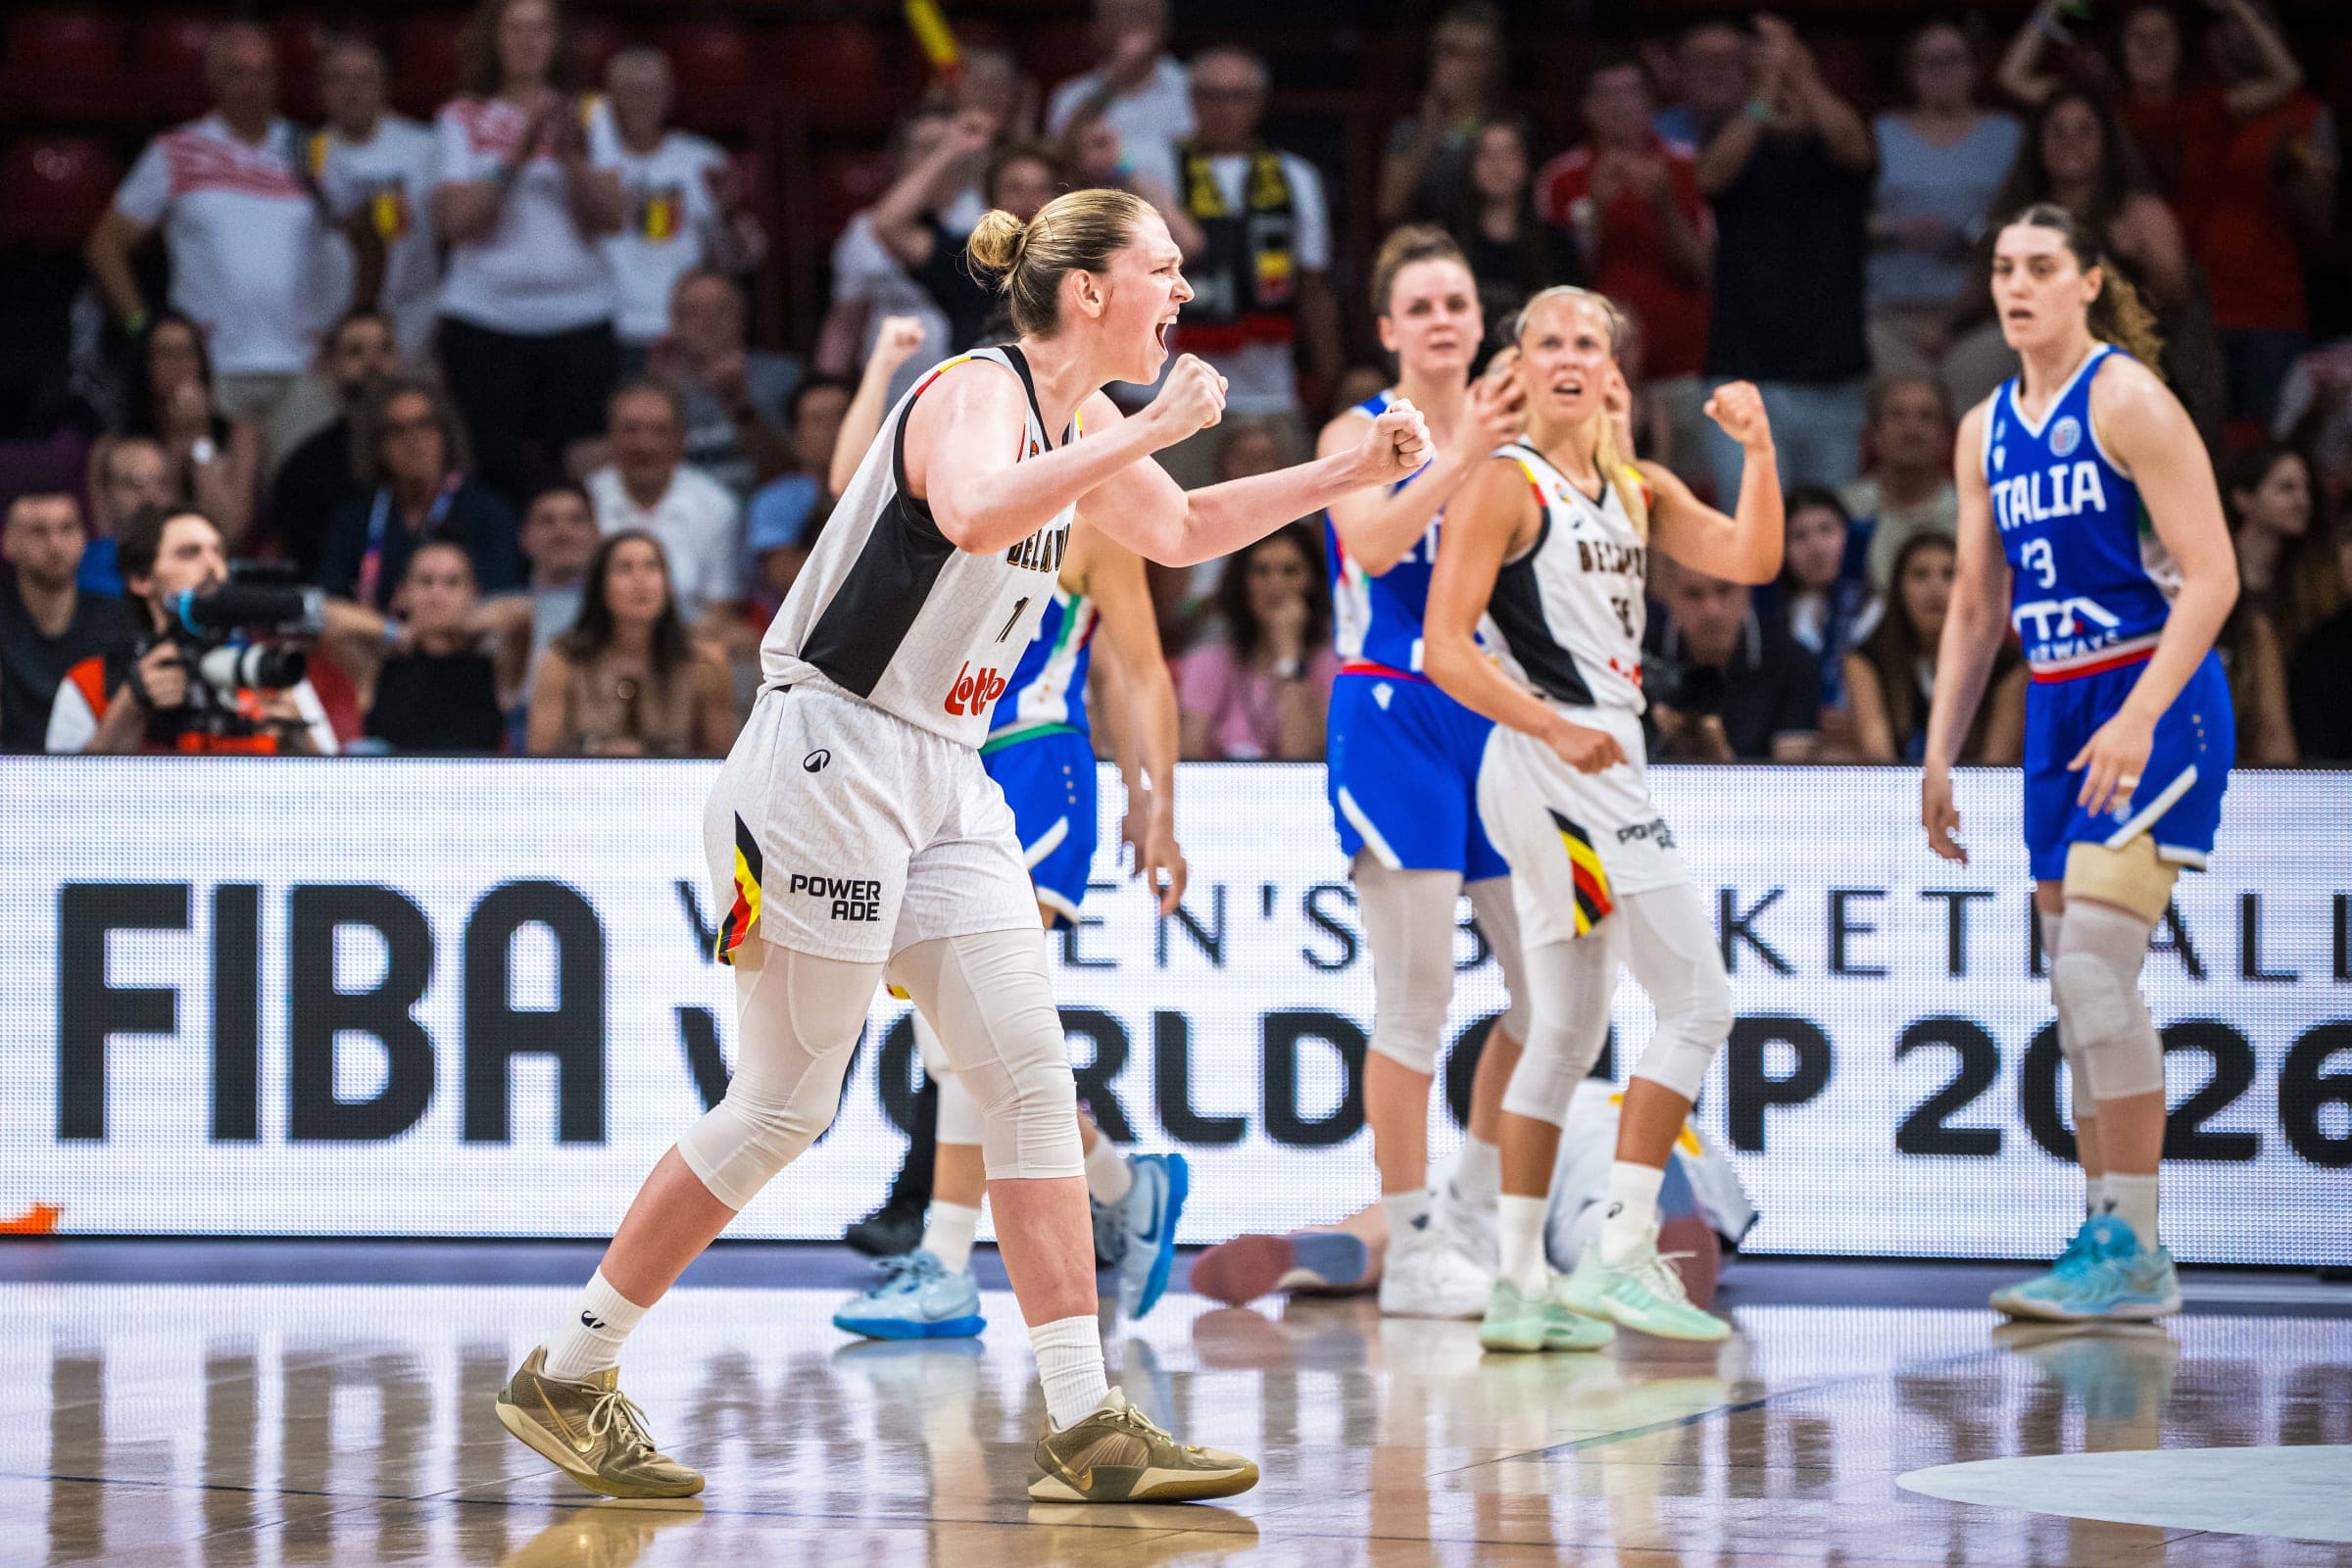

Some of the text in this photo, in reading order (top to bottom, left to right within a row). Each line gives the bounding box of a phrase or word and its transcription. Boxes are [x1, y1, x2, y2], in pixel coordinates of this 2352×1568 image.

[1992, 461, 2107, 530] TALIA
[675, 880, 1360, 970] EN'S
[789, 873, 881, 901] POWER
[57, 879, 608, 1143] FIBA
[674, 1005, 1370, 1145] RLD
